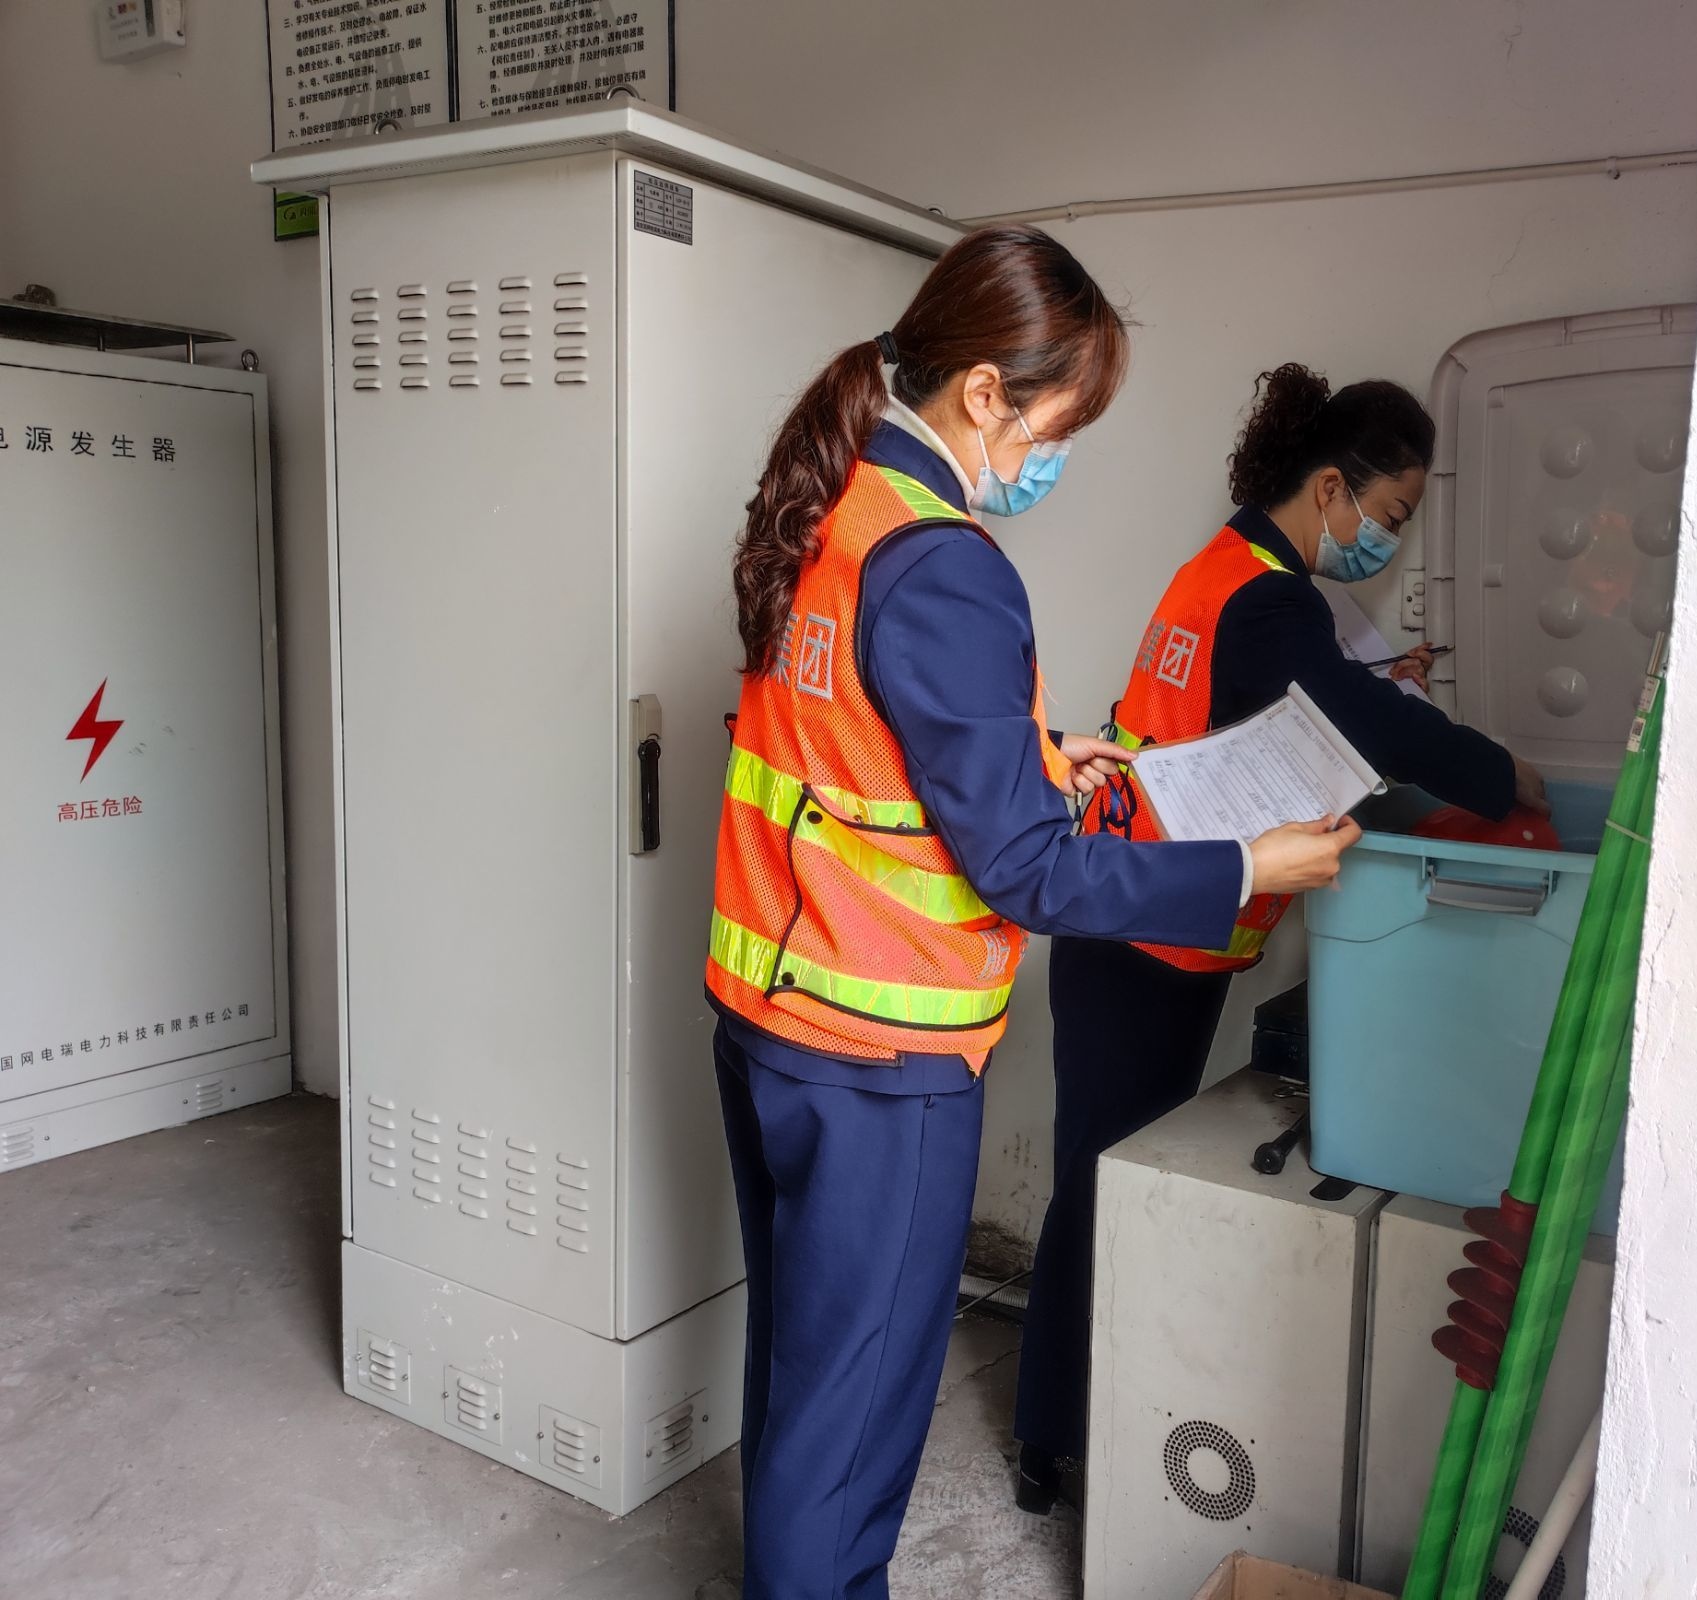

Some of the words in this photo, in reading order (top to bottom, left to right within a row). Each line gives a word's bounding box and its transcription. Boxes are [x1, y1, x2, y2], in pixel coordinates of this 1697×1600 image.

[57, 796, 143, 822] 高压危险
[0, 1003, 250, 1071] 国网电瑞电力科技有限责任公司
